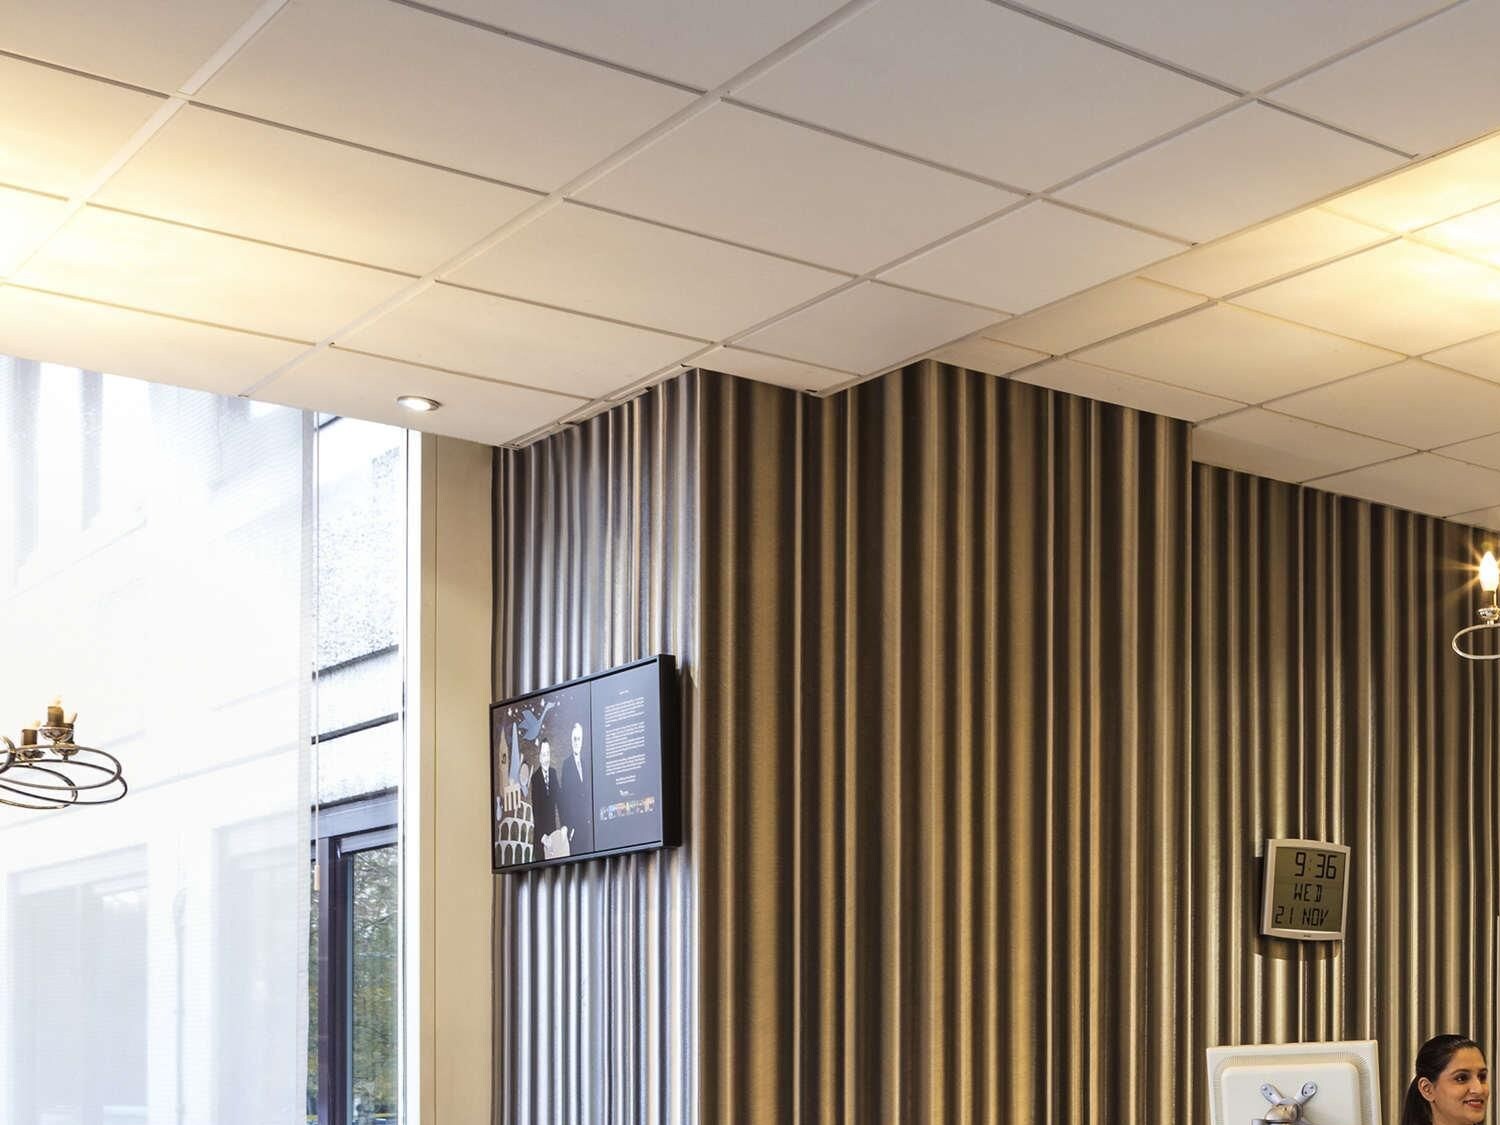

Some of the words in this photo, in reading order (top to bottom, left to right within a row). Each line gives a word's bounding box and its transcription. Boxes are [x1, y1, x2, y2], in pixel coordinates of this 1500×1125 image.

[1294, 883, 1322, 902] WED
[1275, 906, 1294, 924] 21
[1302, 908, 1329, 926] NOV
